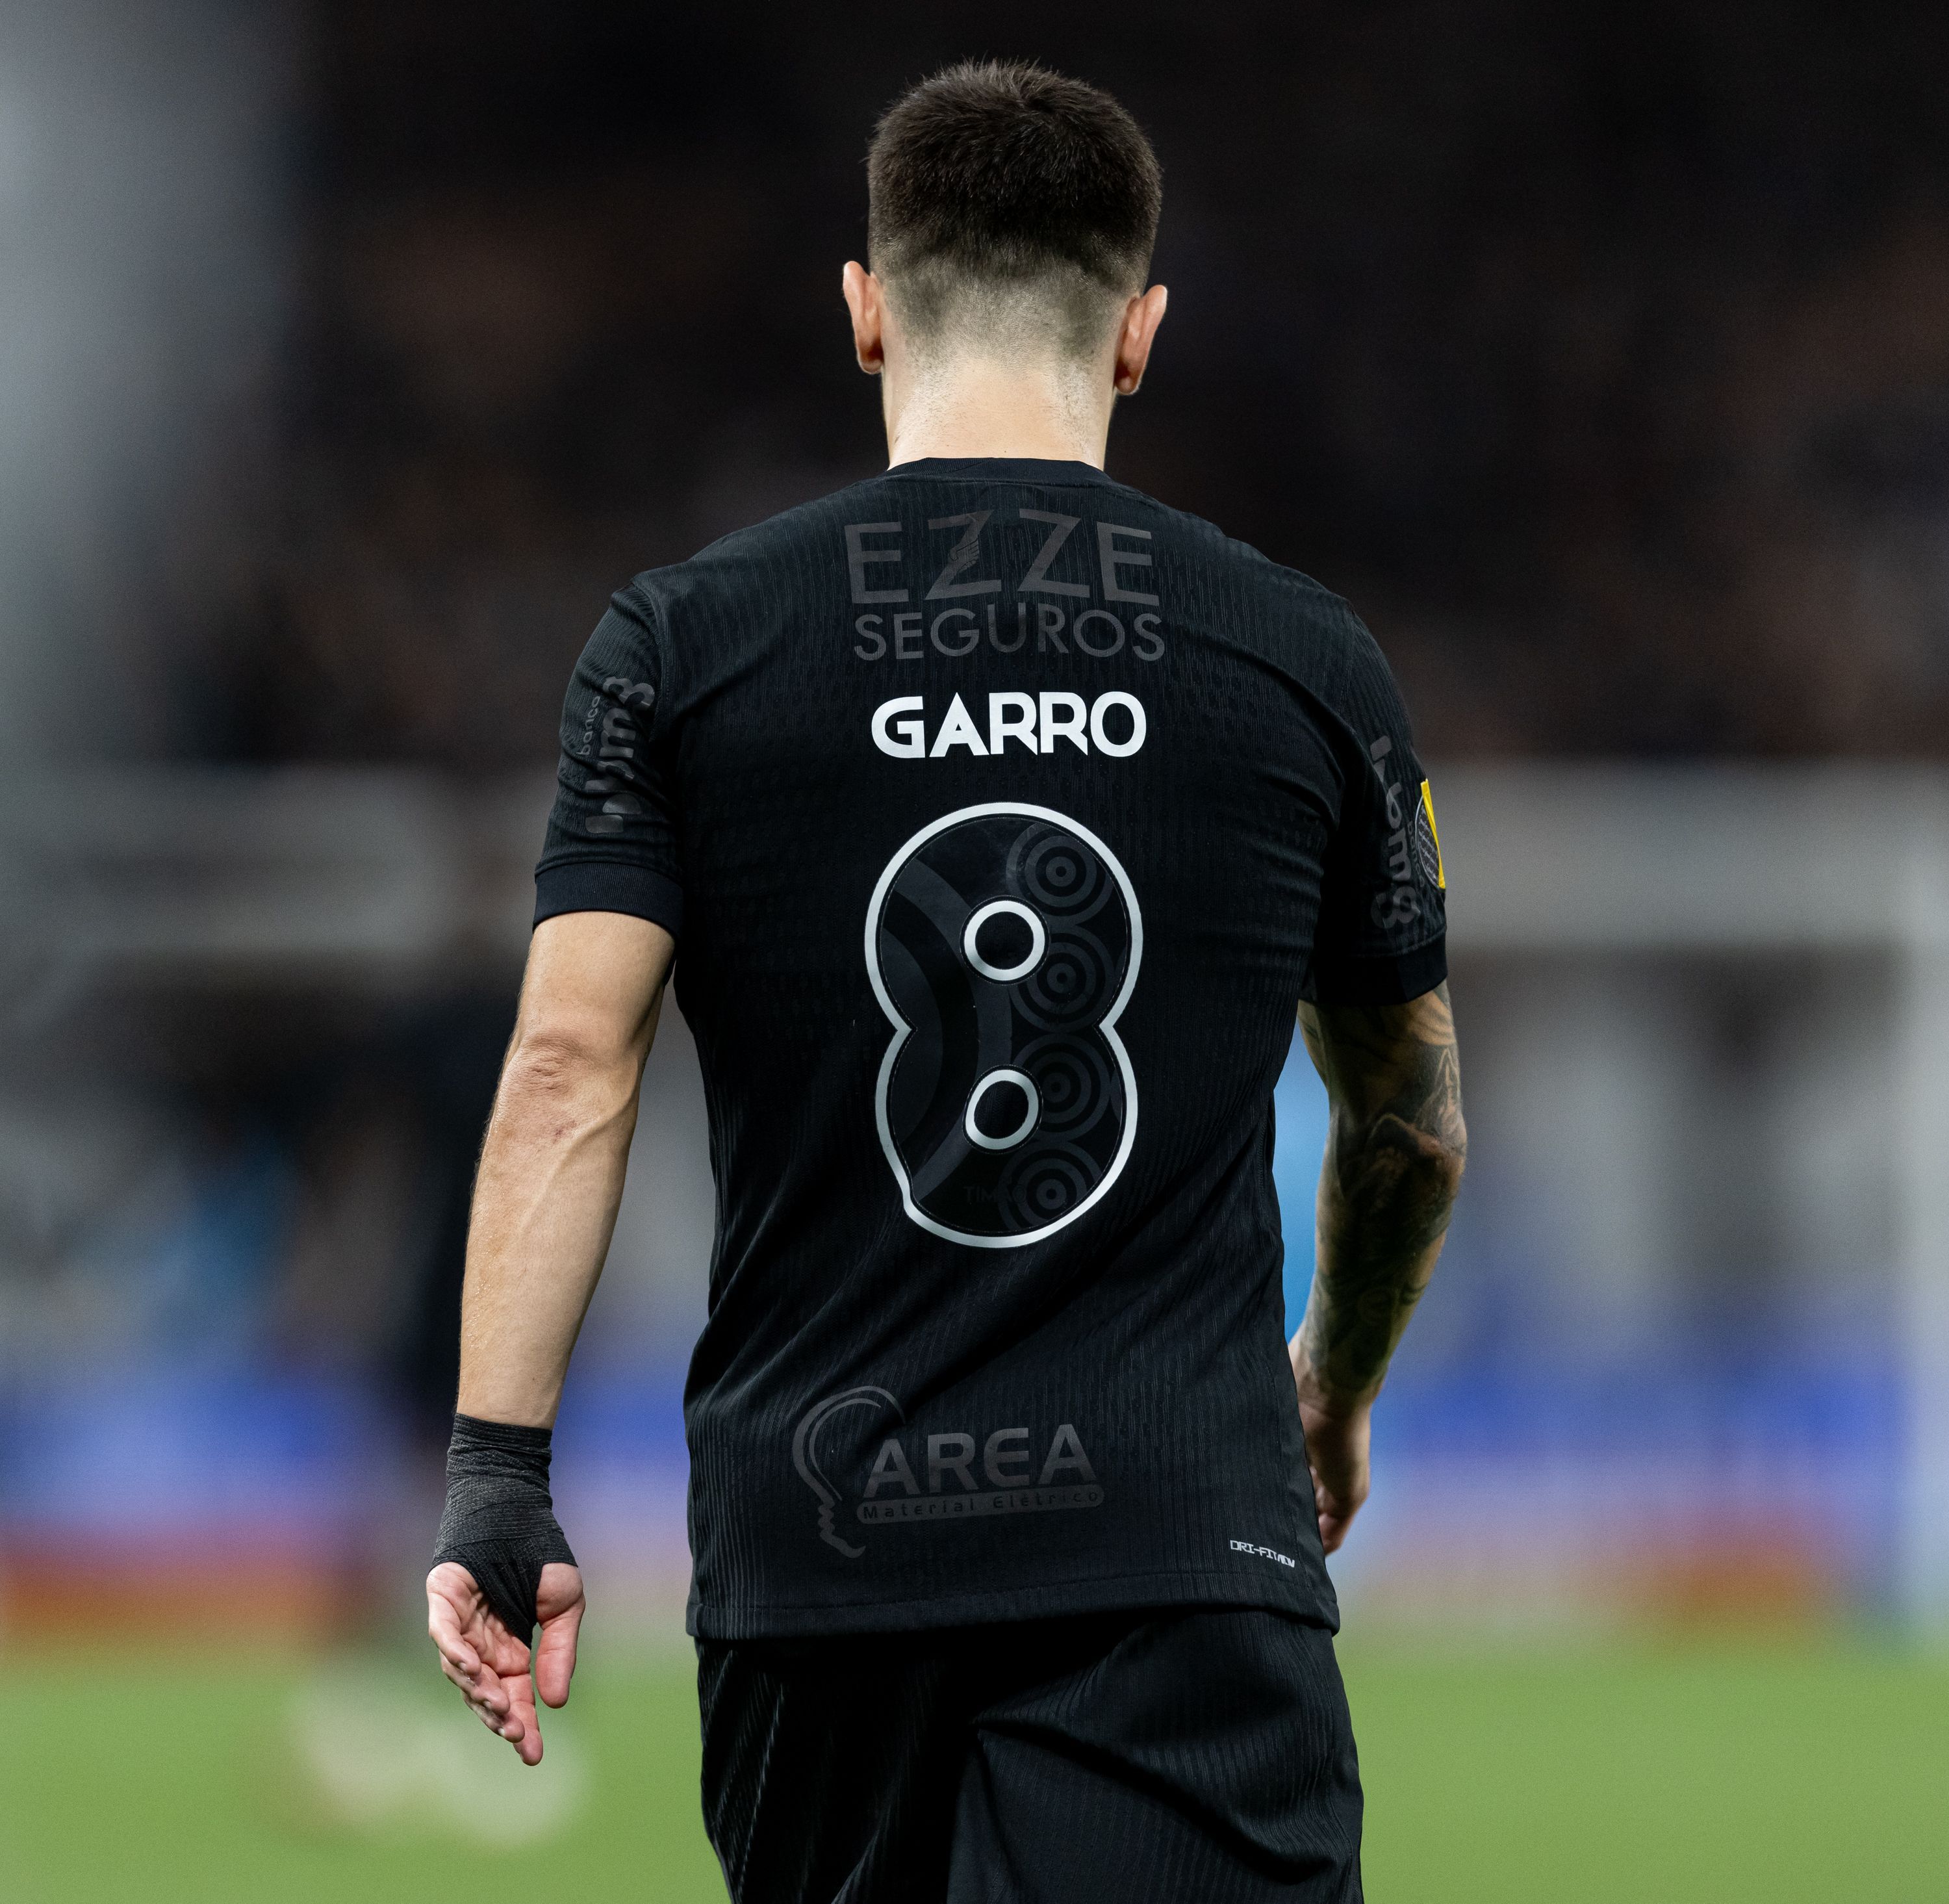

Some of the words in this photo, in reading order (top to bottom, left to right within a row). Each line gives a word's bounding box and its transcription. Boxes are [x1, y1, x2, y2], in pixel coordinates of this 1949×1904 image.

[845, 509, 1159, 606] EZZE
[854, 602, 1166, 662] SEGUROS
[576, 696, 601, 755] banco
[871, 691, 1147, 758] GARRO
[864, 802, 1143, 1248] 8
[863, 1424, 1097, 1498] AREA
[863, 1500, 974, 1519] Material
[1230, 1540, 1277, 1561] DRI-FIT
